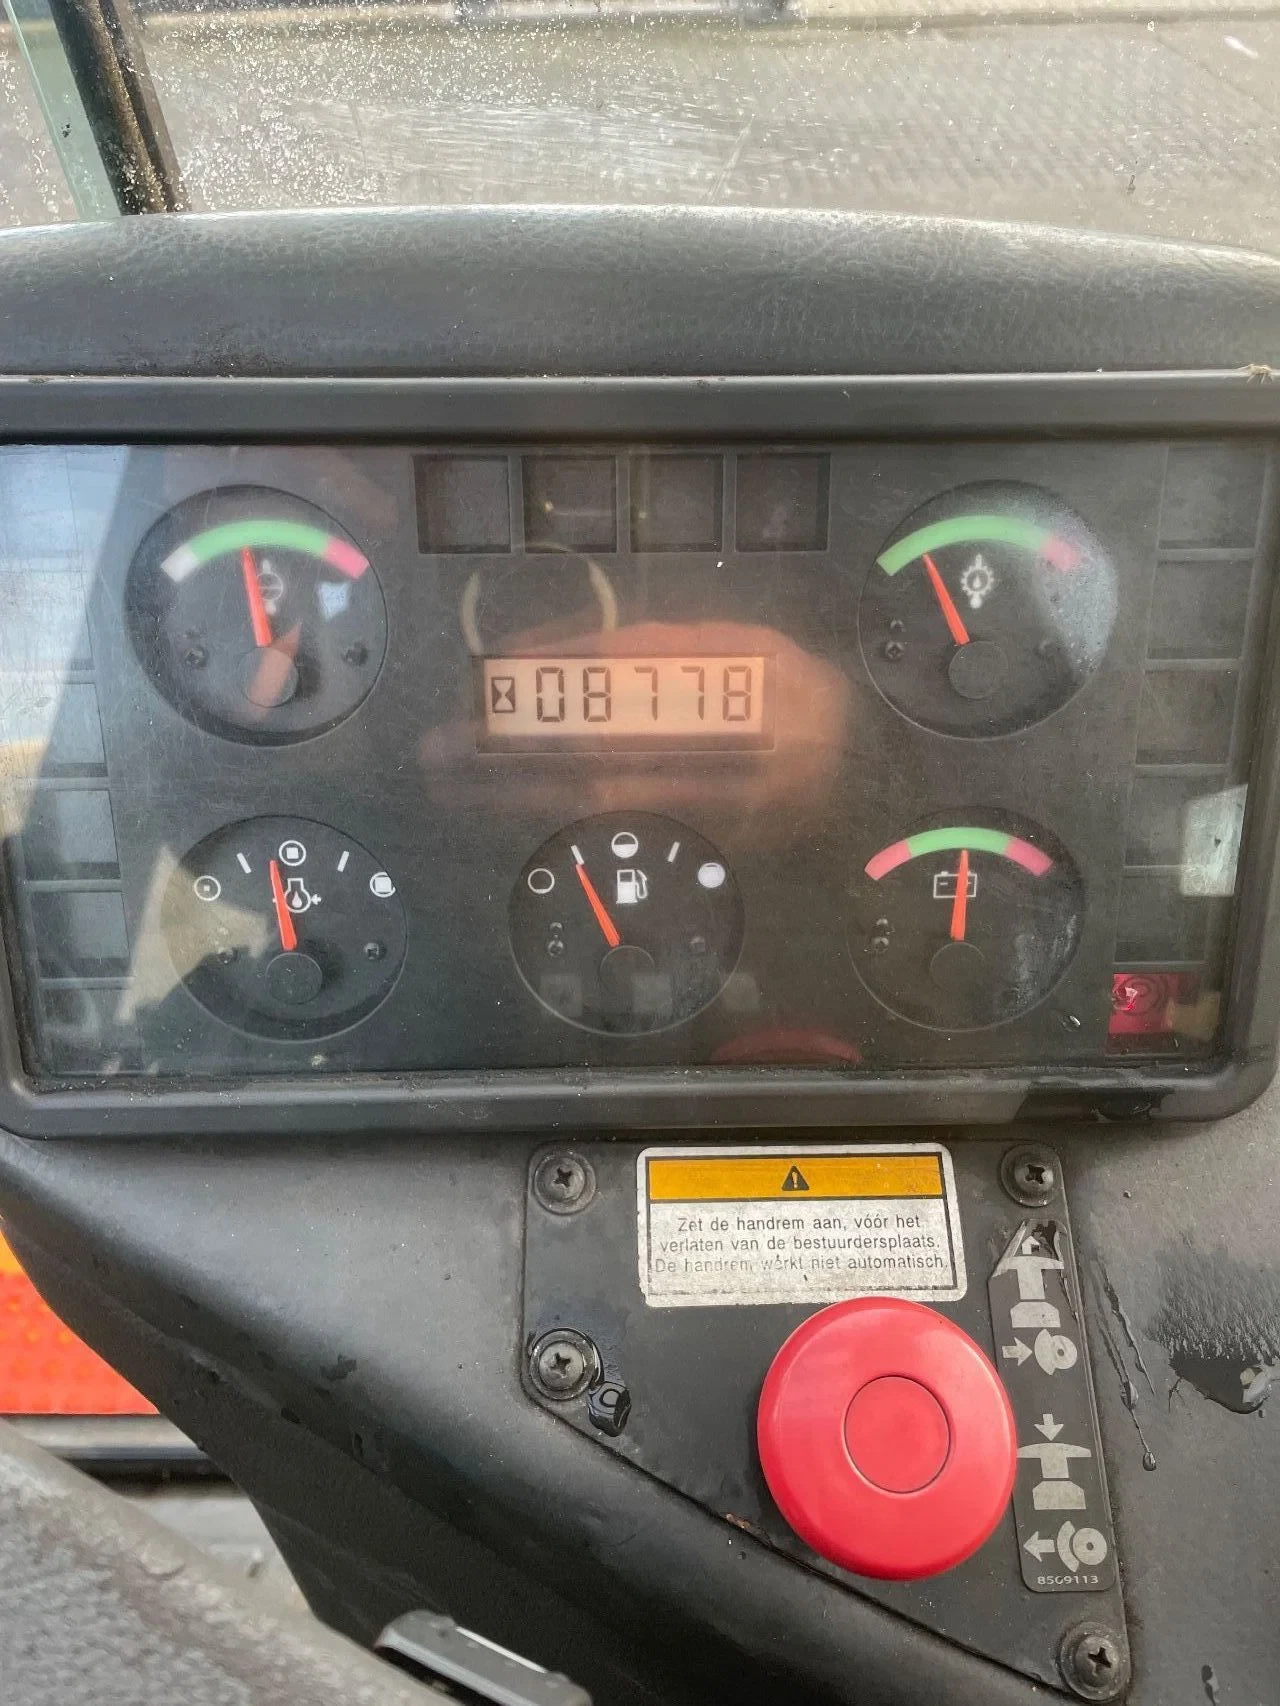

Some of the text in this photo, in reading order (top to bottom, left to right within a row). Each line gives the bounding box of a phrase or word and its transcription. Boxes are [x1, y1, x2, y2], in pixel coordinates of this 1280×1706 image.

[535, 665, 752, 723] 08778
[676, 1213, 921, 1232] Zet de handrem aan, vóór het
[660, 1233, 940, 1253] verlaten van de bestuurdersplaats.
[655, 1258, 677, 1273] De
[811, 1254, 841, 1270] niet
[847, 1253, 949, 1270] automatisch.
